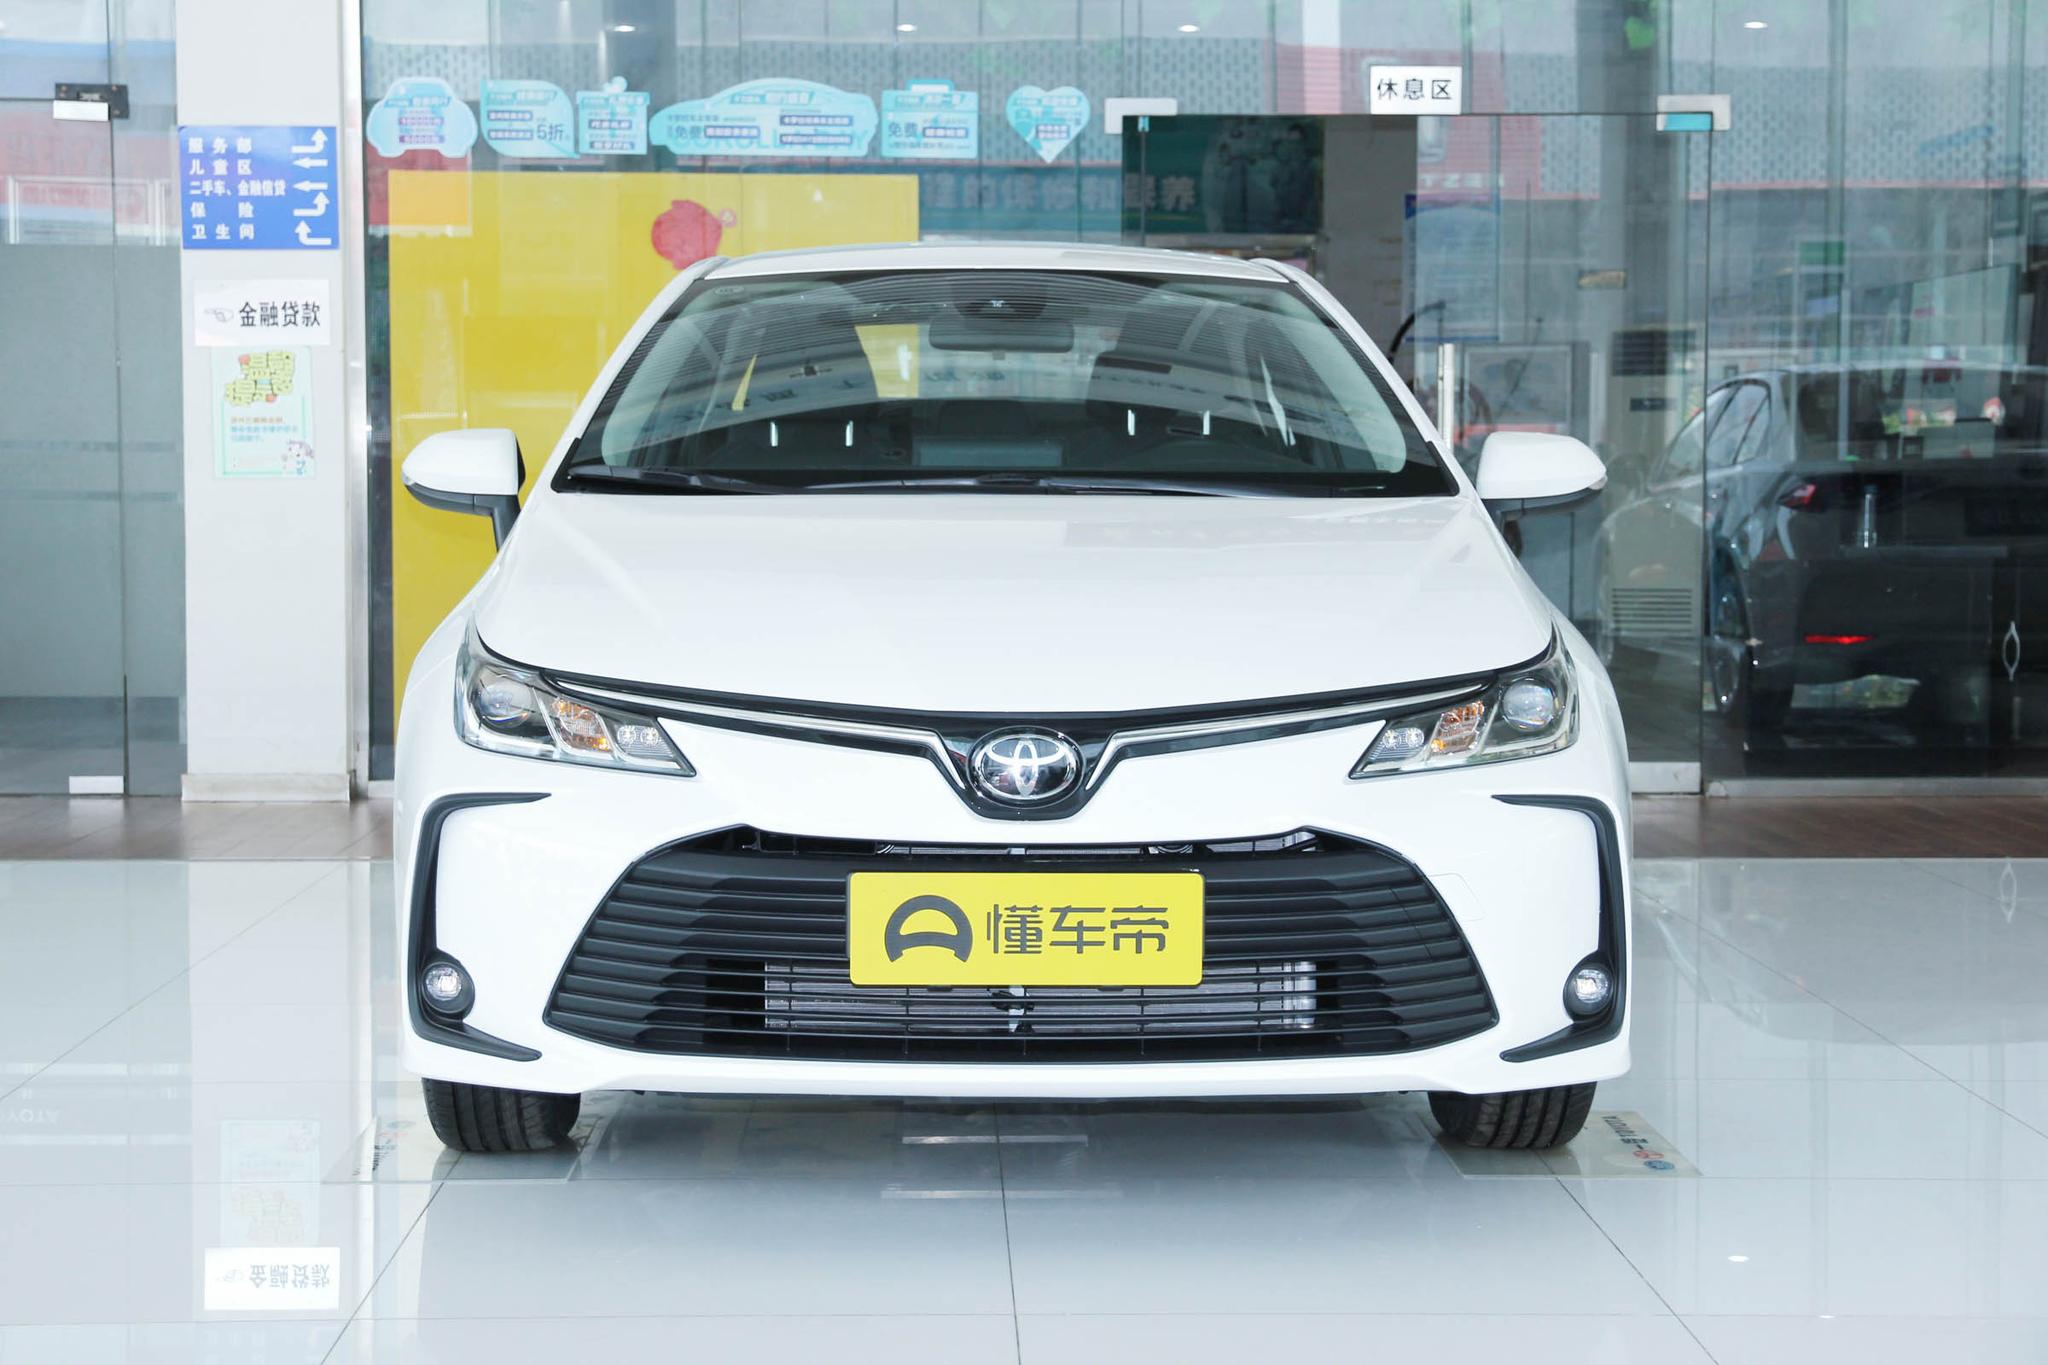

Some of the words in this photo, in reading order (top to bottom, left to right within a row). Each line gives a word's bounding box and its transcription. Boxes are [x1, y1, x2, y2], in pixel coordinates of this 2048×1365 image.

[1376, 78, 1453, 100] 休息区
[536, 123, 565, 141] 5折
[888, 121, 918, 138] 免费
[187, 137, 252, 154] 服务部
[189, 159, 252, 176] 儿童区
[190, 201, 254, 219] 保险
[191, 223, 255, 240] 卫生间
[239, 301, 321, 329] 金融贷款
[986, 903, 1170, 954] 懂车帝
